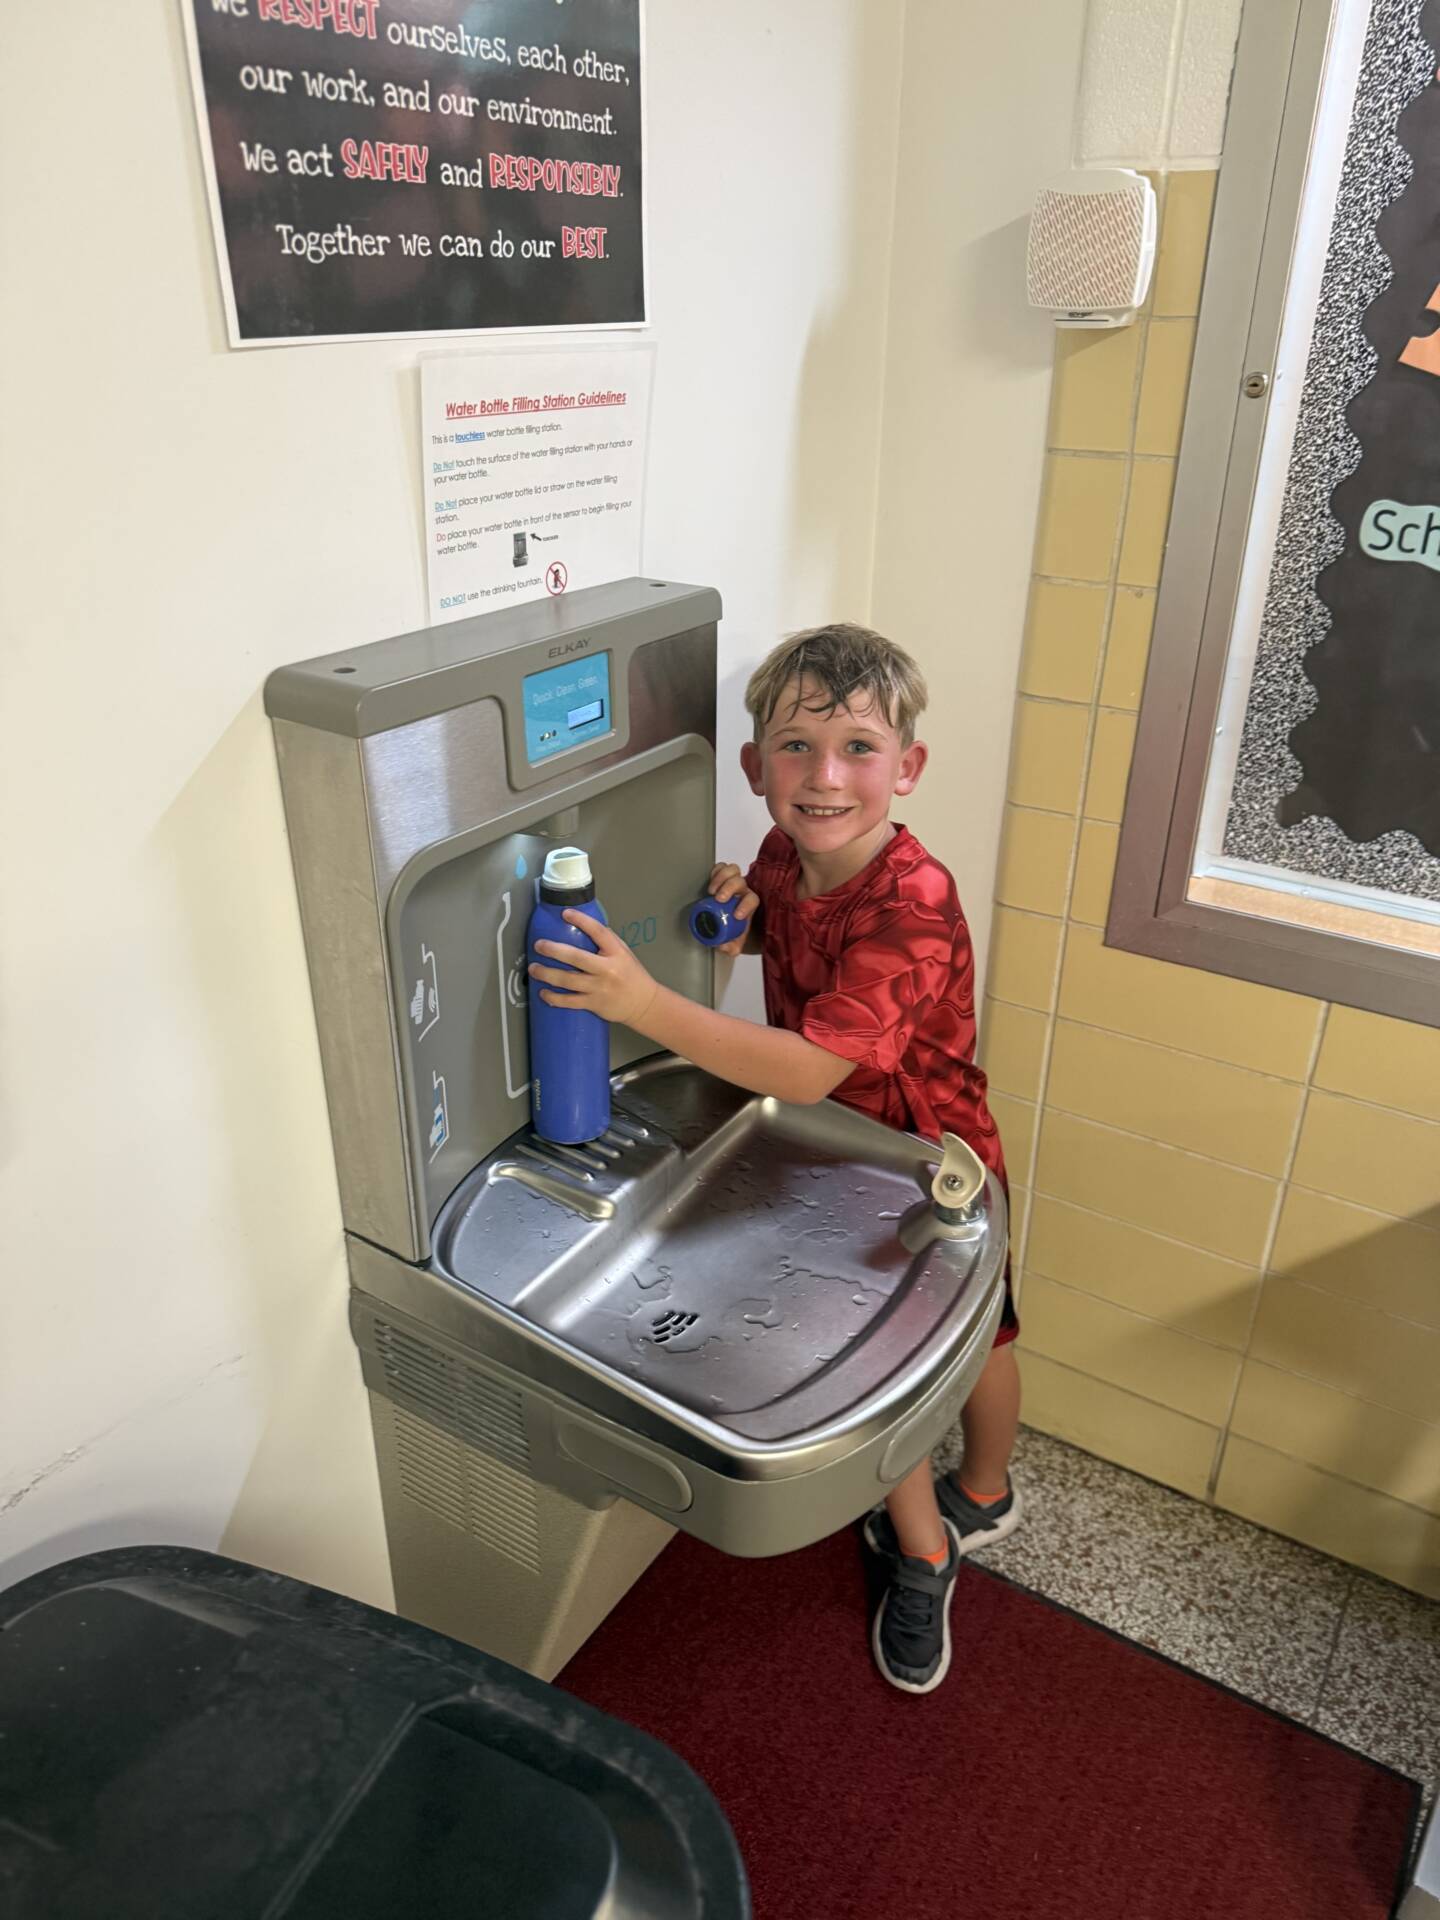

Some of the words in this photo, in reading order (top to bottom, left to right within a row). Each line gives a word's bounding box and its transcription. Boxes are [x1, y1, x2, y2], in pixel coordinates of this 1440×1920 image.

[387, 22, 512, 65] ourselves,
[518, 44, 567, 74] each
[573, 49, 629, 86] other,
[240, 65, 293, 94] our
[301, 68, 375, 107] work,
[383, 80, 431, 112] and
[438, 94, 480, 117] our
[487, 97, 617, 134] environment.
[239, 141, 279, 173] We
[286, 143, 334, 177] act
[341, 138, 429, 183] SAFELY
[440, 158, 483, 188] and
[275, 223, 391, 264] Together
[398, 234, 432, 256] we
[439, 234, 484, 258] can
[490, 229, 514, 258] do
[521, 239, 556, 258] our
[561, 226, 610, 259] BEST.
[446, 401, 478, 417] Water
[480, 398, 509, 414] Bottle
[512, 396, 540, 411] Filling
[543, 394, 575, 409] Station
[578, 391, 626, 406] Guidelines
[432, 435, 442, 444] This
[443, 434, 448, 443] is
[455, 432, 485, 443] touchless
[486, 429, 505, 438] water
[506, 427, 524, 436] bottle
[526, 424, 540, 434] filling
[433, 462, 442, 472] Do
[443, 460, 455, 470] Not
[456, 457, 475, 467] touch
[476, 456, 487, 465] the
[488, 453, 511, 463] surface
[512, 452, 519, 460] of
[520, 451, 530, 459] the
[531, 449, 548, 457] water
[549, 446, 564, 456] filling
[565, 445, 583, 454] station
[584, 443, 595, 451] with
[597, 443, 608, 452] your
[609, 440, 626, 448] hands
[627, 439, 632, 447] or
[433, 475, 448, 487] your
[448, 472, 467, 481] water
[435, 502, 444, 512] Do
[446, 499, 457, 509] Not
[458, 497, 478, 507] place
[480, 494, 494, 504] your
[495, 491, 513, 500] water
[515, 488, 533, 497] bottle
[550, 483, 565, 492] straw
[586, 478, 603, 486] water
[604, 475, 618, 484] filling
[435, 514, 459, 525] station.
[436, 533, 446, 542] Do
[448, 530, 467, 541] place
[469, 527, 482, 538] your
[484, 523, 502, 532] water
[504, 520, 522, 529] bottle
[530, 514, 544, 524] front
[545, 513, 551, 522] of
[552, 512, 562, 520] the
[563, 509, 580, 518] sensor
[582, 507, 587, 515] to
[589, 504, 605, 515] begin
[606, 502, 619, 511] filling
[620, 500, 632, 509] your
[1368, 509, 1440, 556] Sch
[437, 545, 456, 555] water
[440, 598, 450, 609] DO
[452, 593, 466, 604] NOT
[468, 592, 479, 600] use
[480, 589, 491, 597] the
[492, 583, 516, 594] drinking
[517, 577, 543, 589] fountain.
[548, 637, 592, 658] ELKAY
